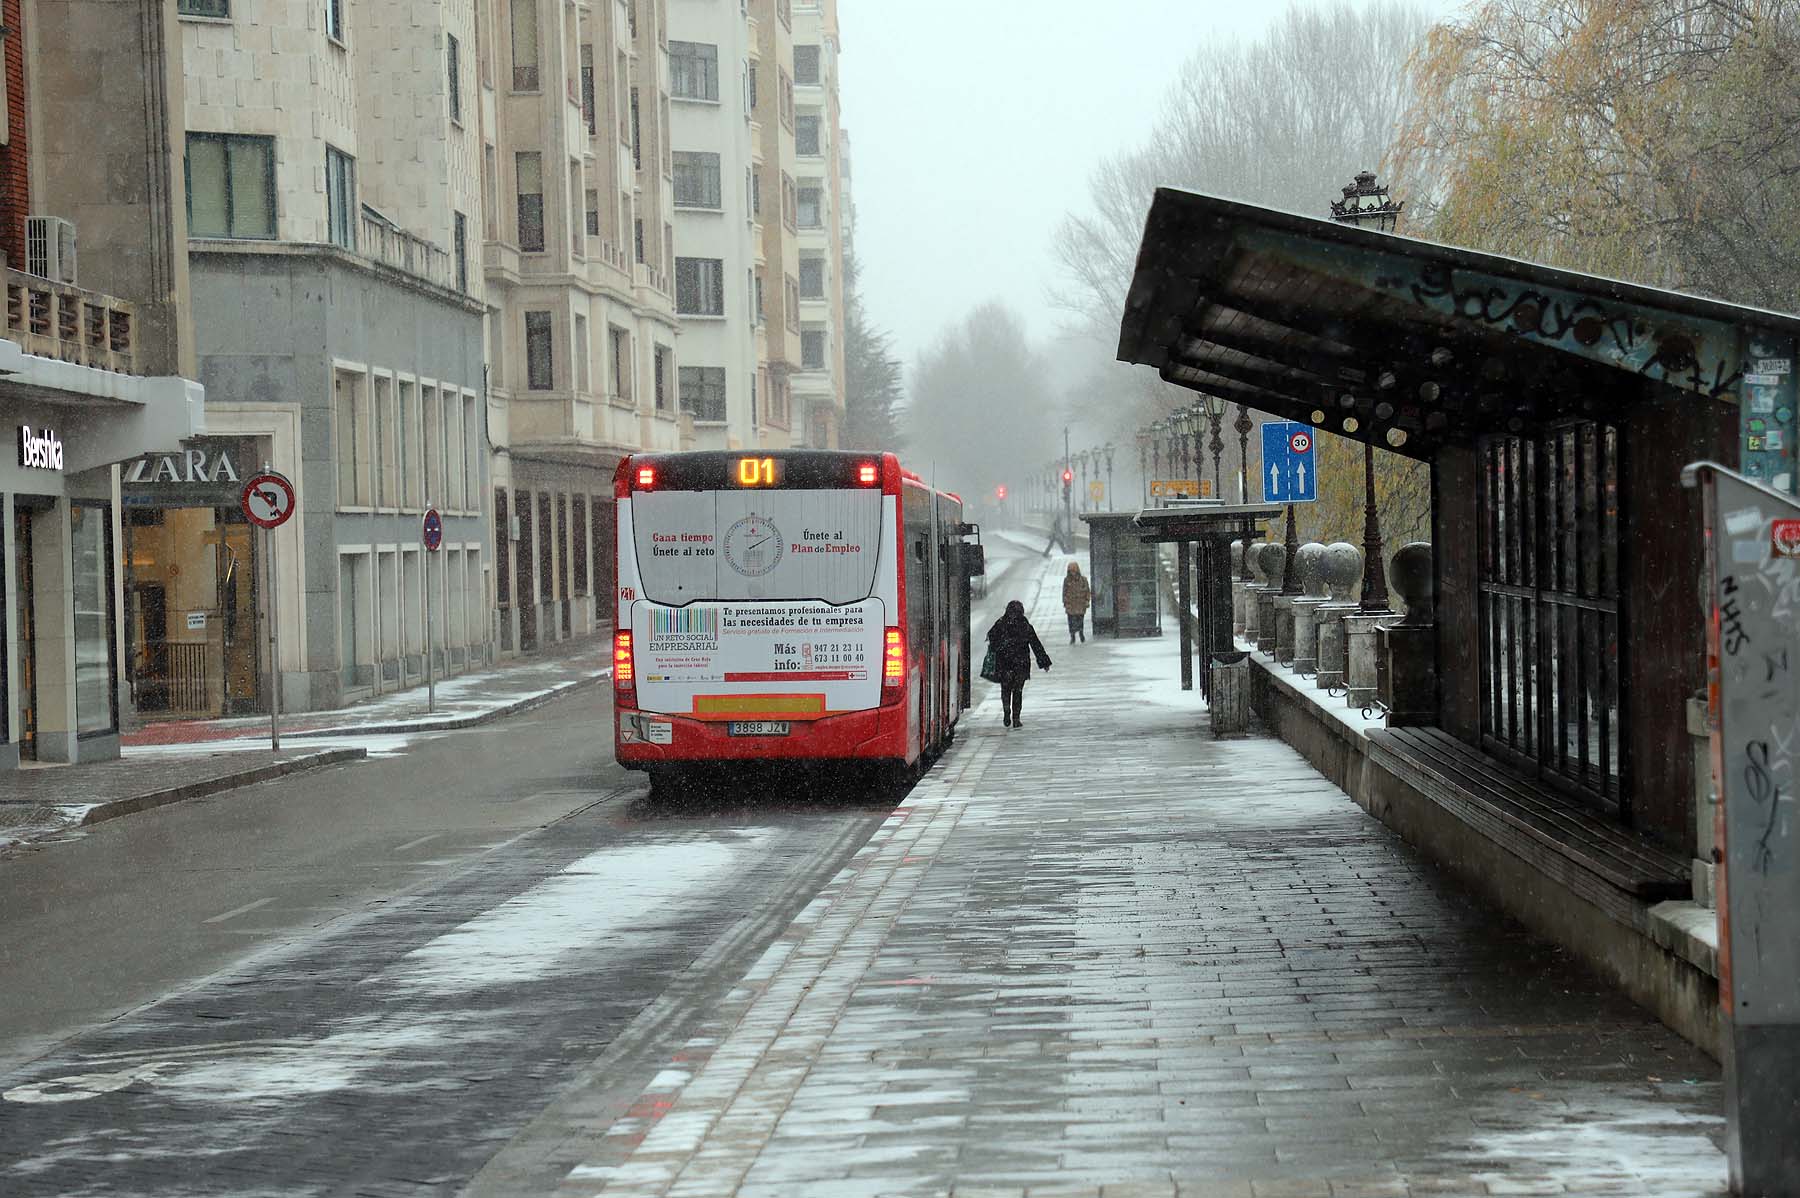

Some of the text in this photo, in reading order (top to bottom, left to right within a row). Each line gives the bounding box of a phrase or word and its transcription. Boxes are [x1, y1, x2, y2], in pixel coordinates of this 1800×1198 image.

[22, 425, 63, 470] Bershka
[1294, 439, 1307, 447] 30
[123, 450, 240, 482] ZARA
[739, 458, 774, 484] 01
[652, 532, 714, 544] Gana tiempo
[803, 528, 843, 540] Únete al
[653, 544, 715, 556] Únete al reto
[791, 543, 861, 555] Plan de Empleo
[723, 606, 863, 617] Te presentamos profesionales para
[723, 617, 864, 628] las necesidades de tu empresa
[649, 642, 719, 652] EMPRESARIAL
[774, 643, 797, 655] Más
[814, 643, 864, 652] 947 21 23 11
[774, 658, 801, 670] info:
[814, 653, 864, 663] 673 11 00 40
[735, 722, 763, 733] 3898
